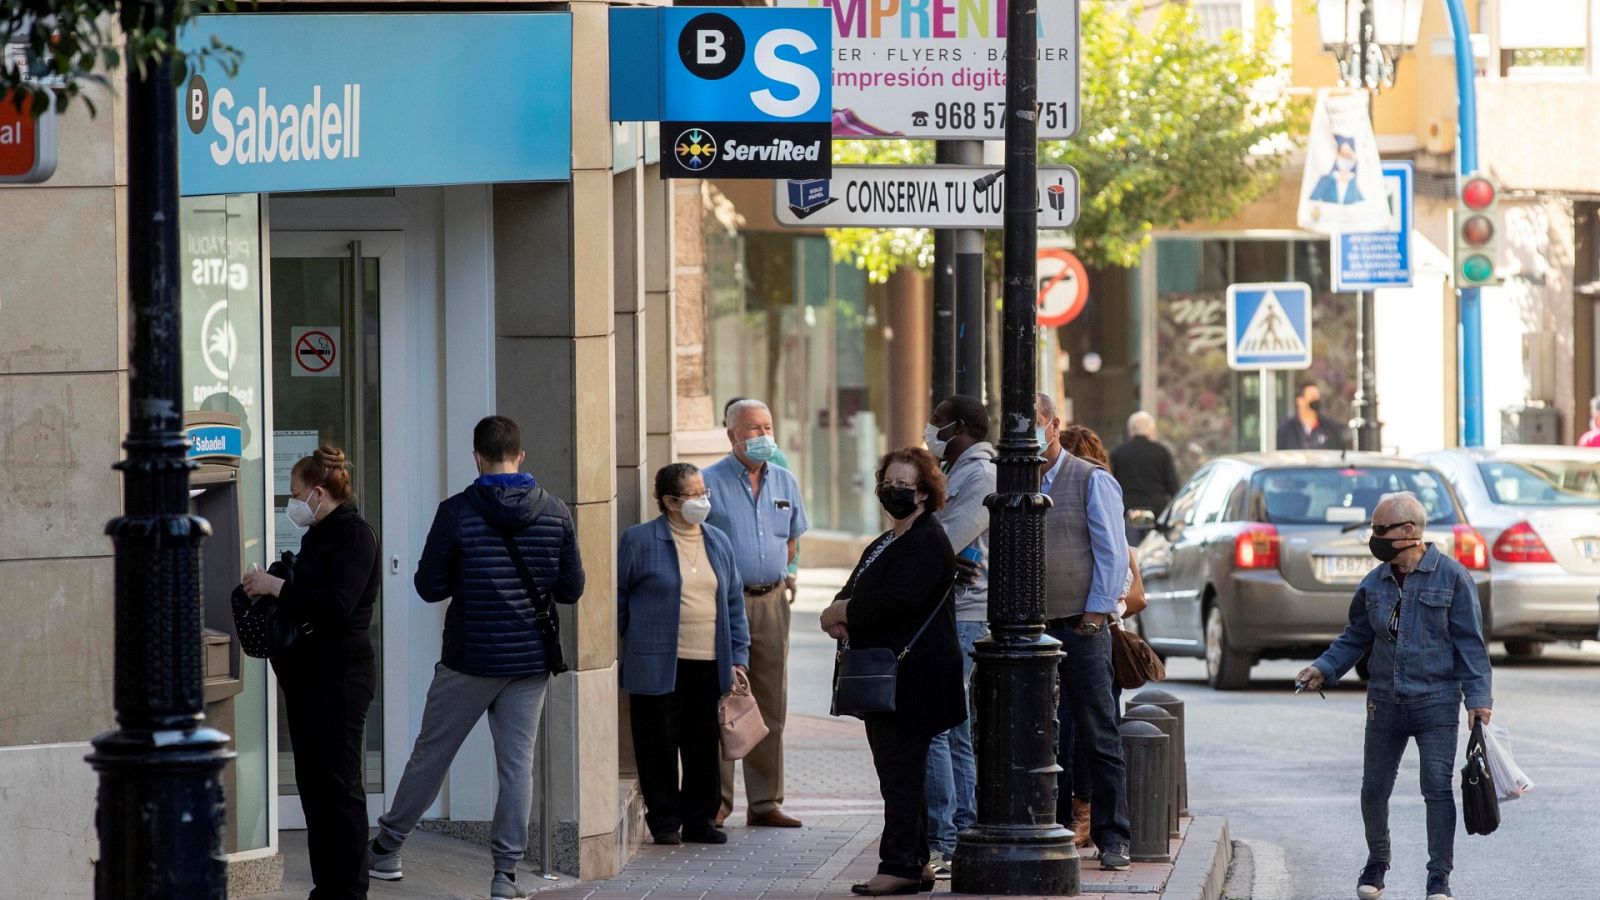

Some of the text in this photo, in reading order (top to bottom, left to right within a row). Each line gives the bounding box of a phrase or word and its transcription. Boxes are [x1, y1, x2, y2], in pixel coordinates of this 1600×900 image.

[832, 48, 862, 61] ER
[887, 48, 963, 61] FLYERS
[696, 28, 821, 118] B S
[831, 65, 1007, 91] impresión digit
[191, 84, 361, 166] B Sabadell
[935, 102, 976, 130] 968
[984, 102, 1007, 130] 57
[722, 138, 821, 162] ServiRed
[807, 192, 825, 201] PAPEL
[809, 186, 824, 194] SOLO
[846, 181, 940, 214] CONSERVA
[945, 181, 967, 214] TU
[195, 435, 226, 452] Sabadell
